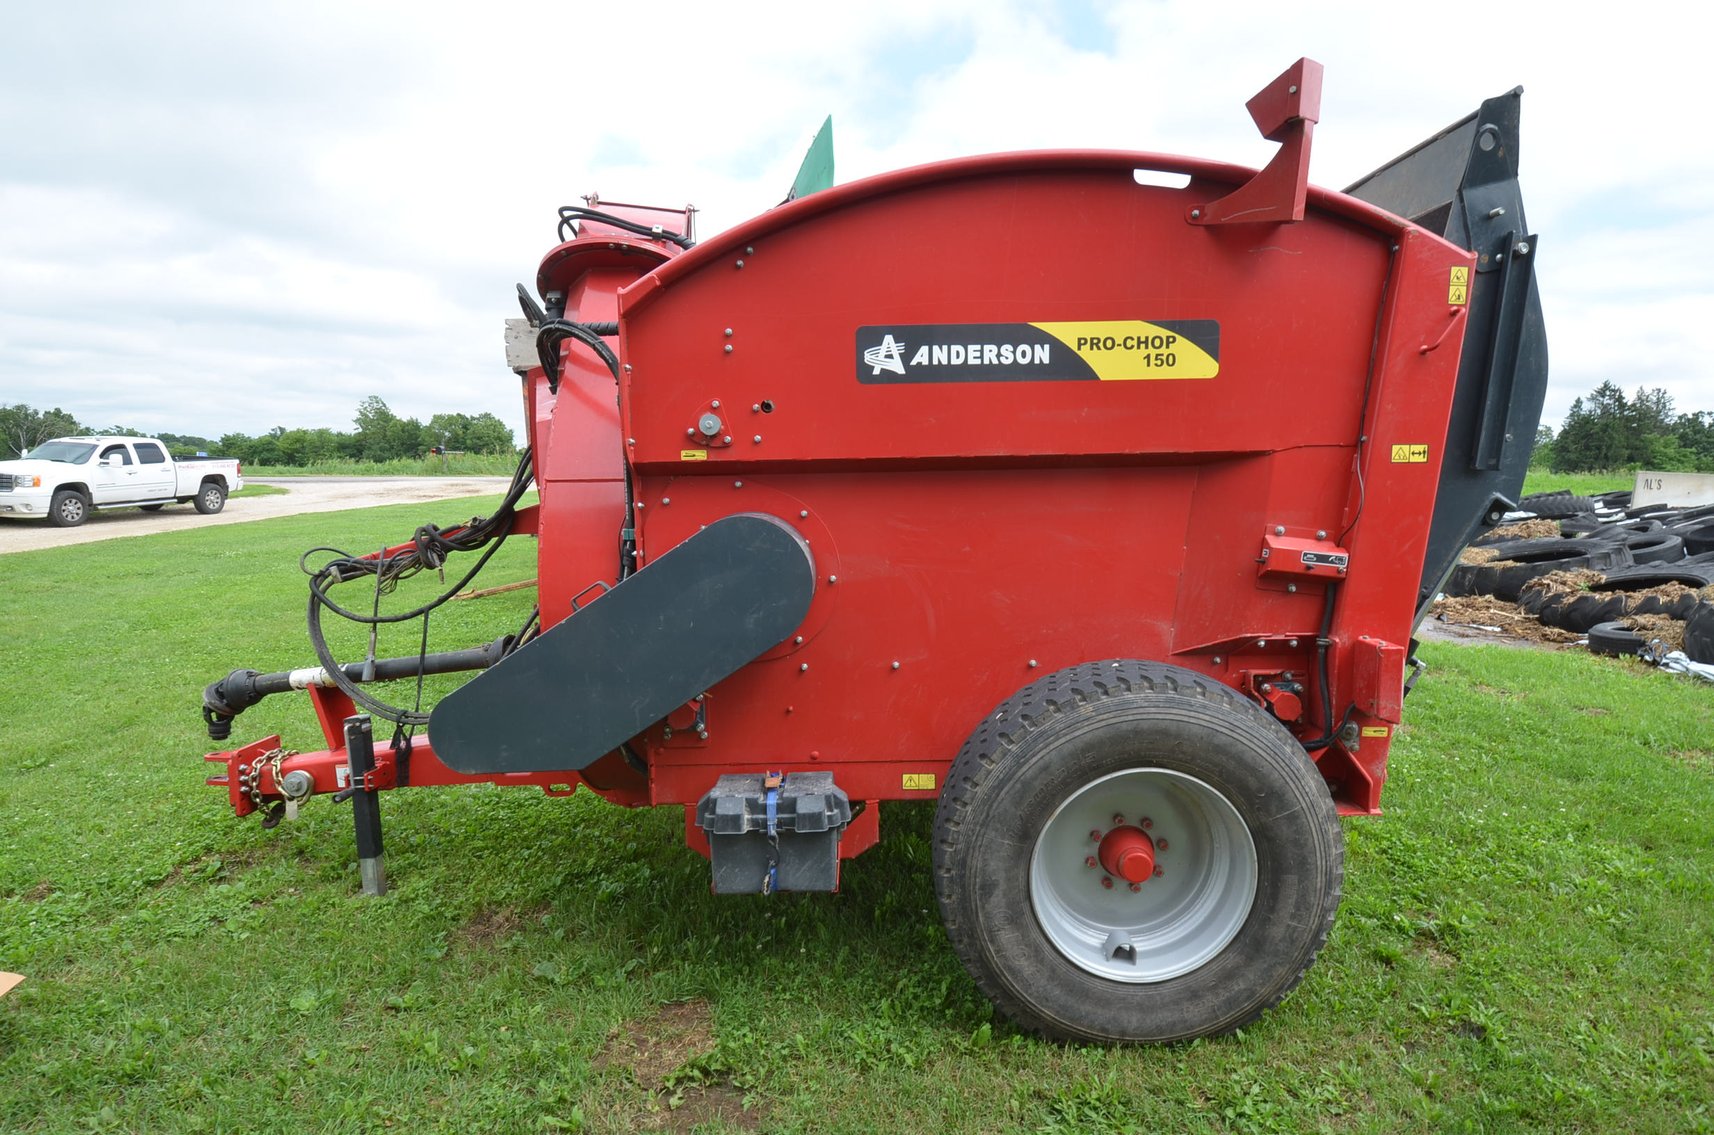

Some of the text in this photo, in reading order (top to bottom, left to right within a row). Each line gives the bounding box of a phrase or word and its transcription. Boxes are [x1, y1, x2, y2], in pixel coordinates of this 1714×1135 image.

[1076, 335, 1177, 351] PRO-CHOP
[909, 344, 1050, 366] ANDERSON
[1143, 353, 1176, 367] 150
[1643, 478, 1663, 490] AL'S
